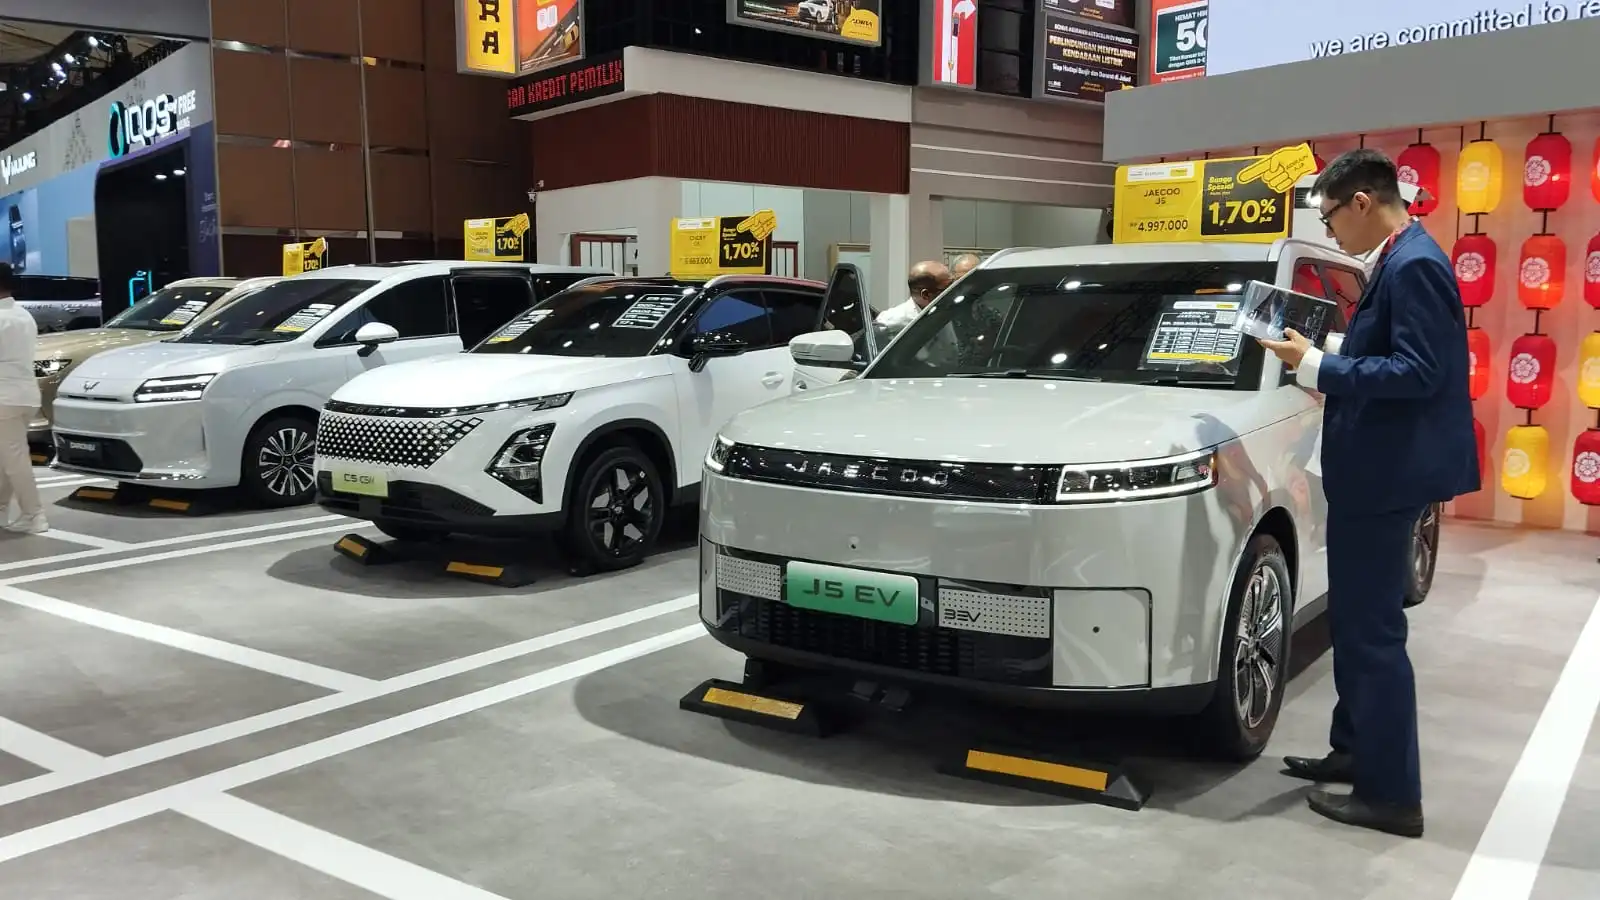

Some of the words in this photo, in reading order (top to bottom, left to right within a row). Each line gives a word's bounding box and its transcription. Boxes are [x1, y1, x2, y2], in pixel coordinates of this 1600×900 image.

[1174, 11, 1196, 22] HEMAT
[1309, 38, 1344, 59] we
[1350, 31, 1390, 53] are
[1396, 3, 1533, 47] committed
[1539, 2, 1568, 25] to
[1049, 35, 1097, 52] PERLINDUNGAN
[1062, 48, 1101, 63] KENDARAAN
[1101, 55, 1124, 67] LISTRIK
[528, 75, 567, 104] KREDIT
[570, 59, 623, 95] PEMILIK
[177, 89, 197, 115] FREE
[124, 93, 171, 147] IQOS
[1208, 176, 1233, 184] Bunga
[1143, 187, 1181, 198] JAECOO
[1208, 198, 1276, 227] 1,70%
[1137, 219, 1189, 232] 4.997.000
[723, 241, 760, 261] 1,70%
[343, 473, 358, 483] C5
[793, 460, 949, 487] JAECOO
[802, 577, 844, 600] J5
[855, 585, 903, 607] EV
[944, 608, 982, 623] BEV
